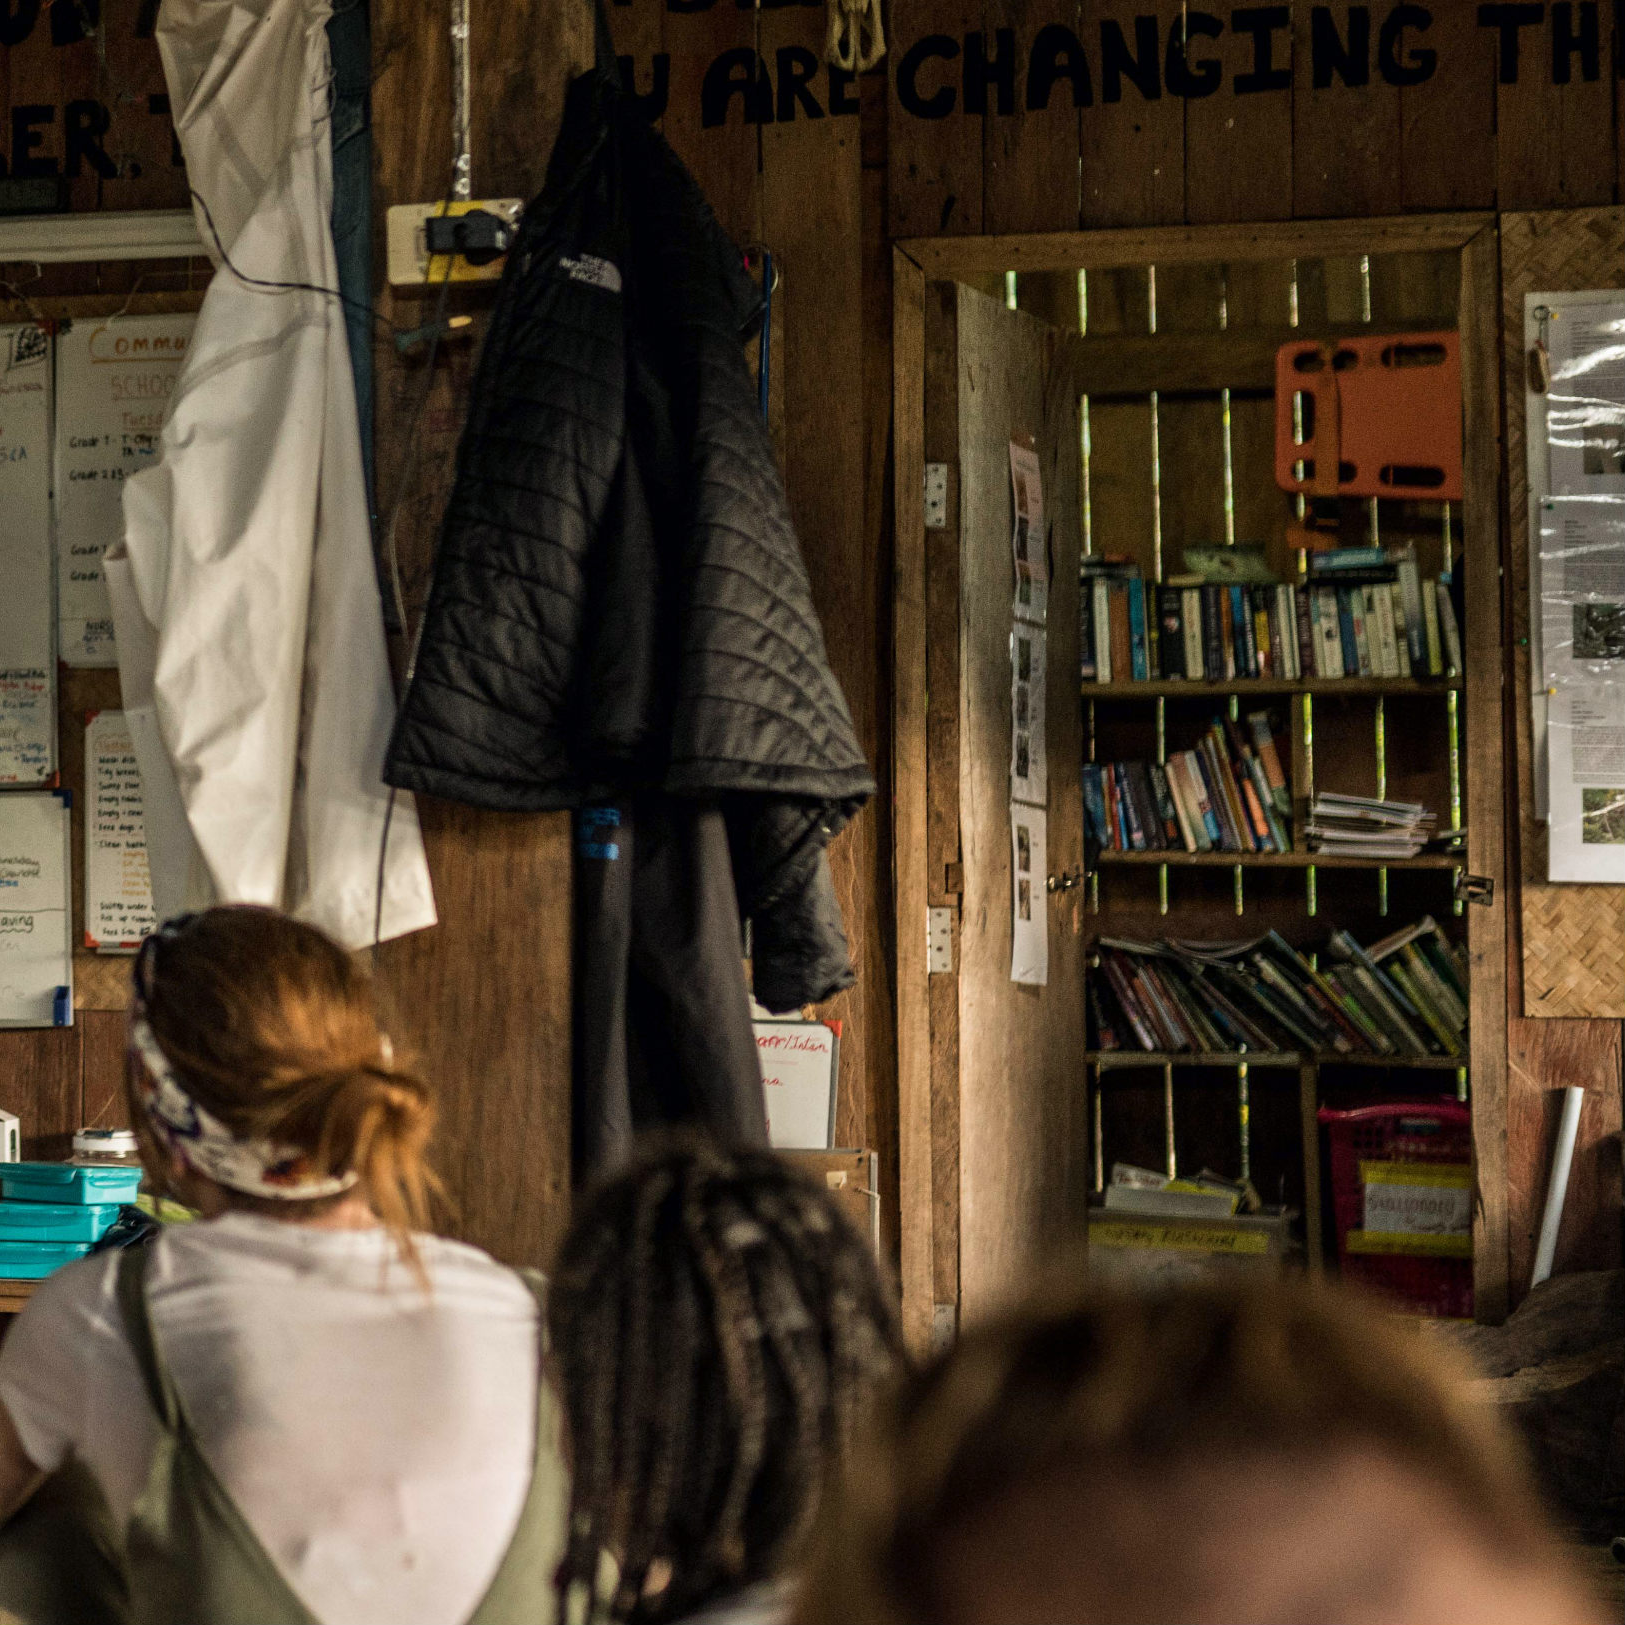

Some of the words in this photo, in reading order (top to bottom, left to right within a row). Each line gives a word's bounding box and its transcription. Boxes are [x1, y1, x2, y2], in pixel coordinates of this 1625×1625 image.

[701, 46, 862, 129] ARE
[895, 5, 1440, 119] CHANGING
[1477, 2, 1625, 86] TH
[88, 326, 192, 358] Commu
